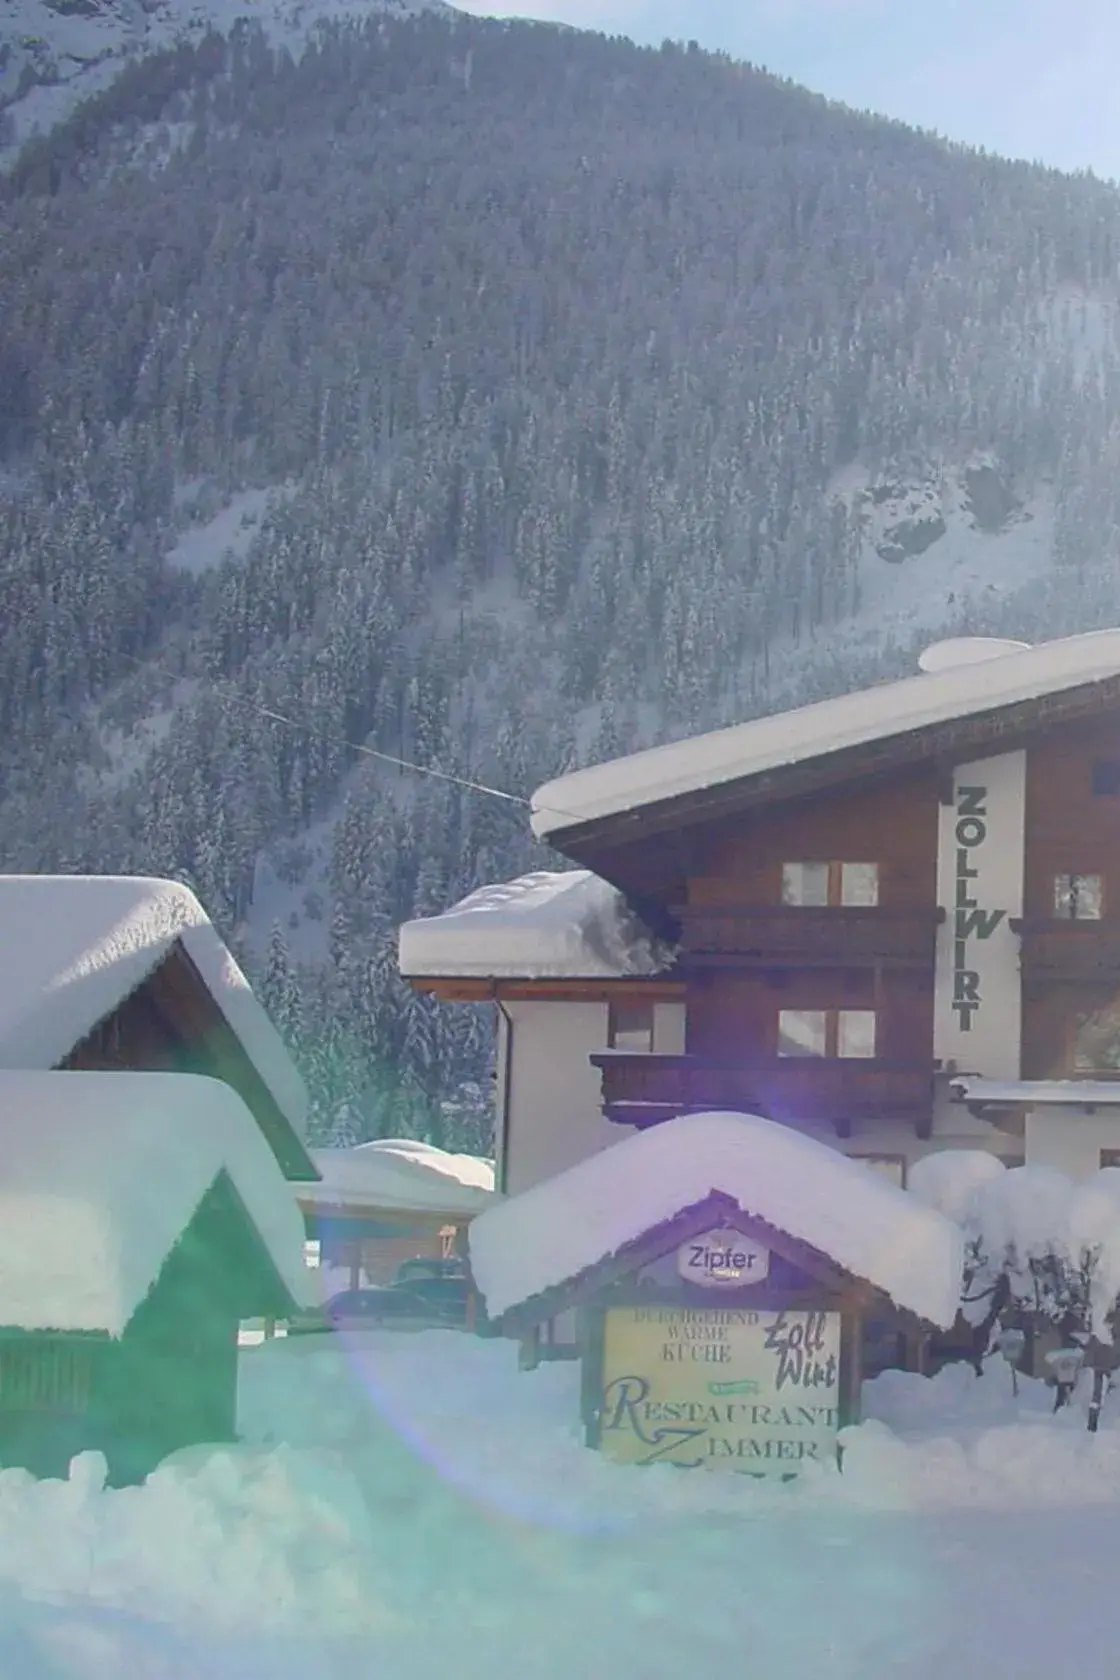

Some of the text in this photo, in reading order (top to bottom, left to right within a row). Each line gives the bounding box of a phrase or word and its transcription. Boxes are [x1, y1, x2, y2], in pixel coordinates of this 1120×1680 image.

[952, 786, 1007, 1032] ZOLLWIRT
[688, 1245, 757, 1271] Zipfer
[602, 1376, 840, 1444] RESTAURANT
[636, 1428, 821, 1467] ZIMMER
